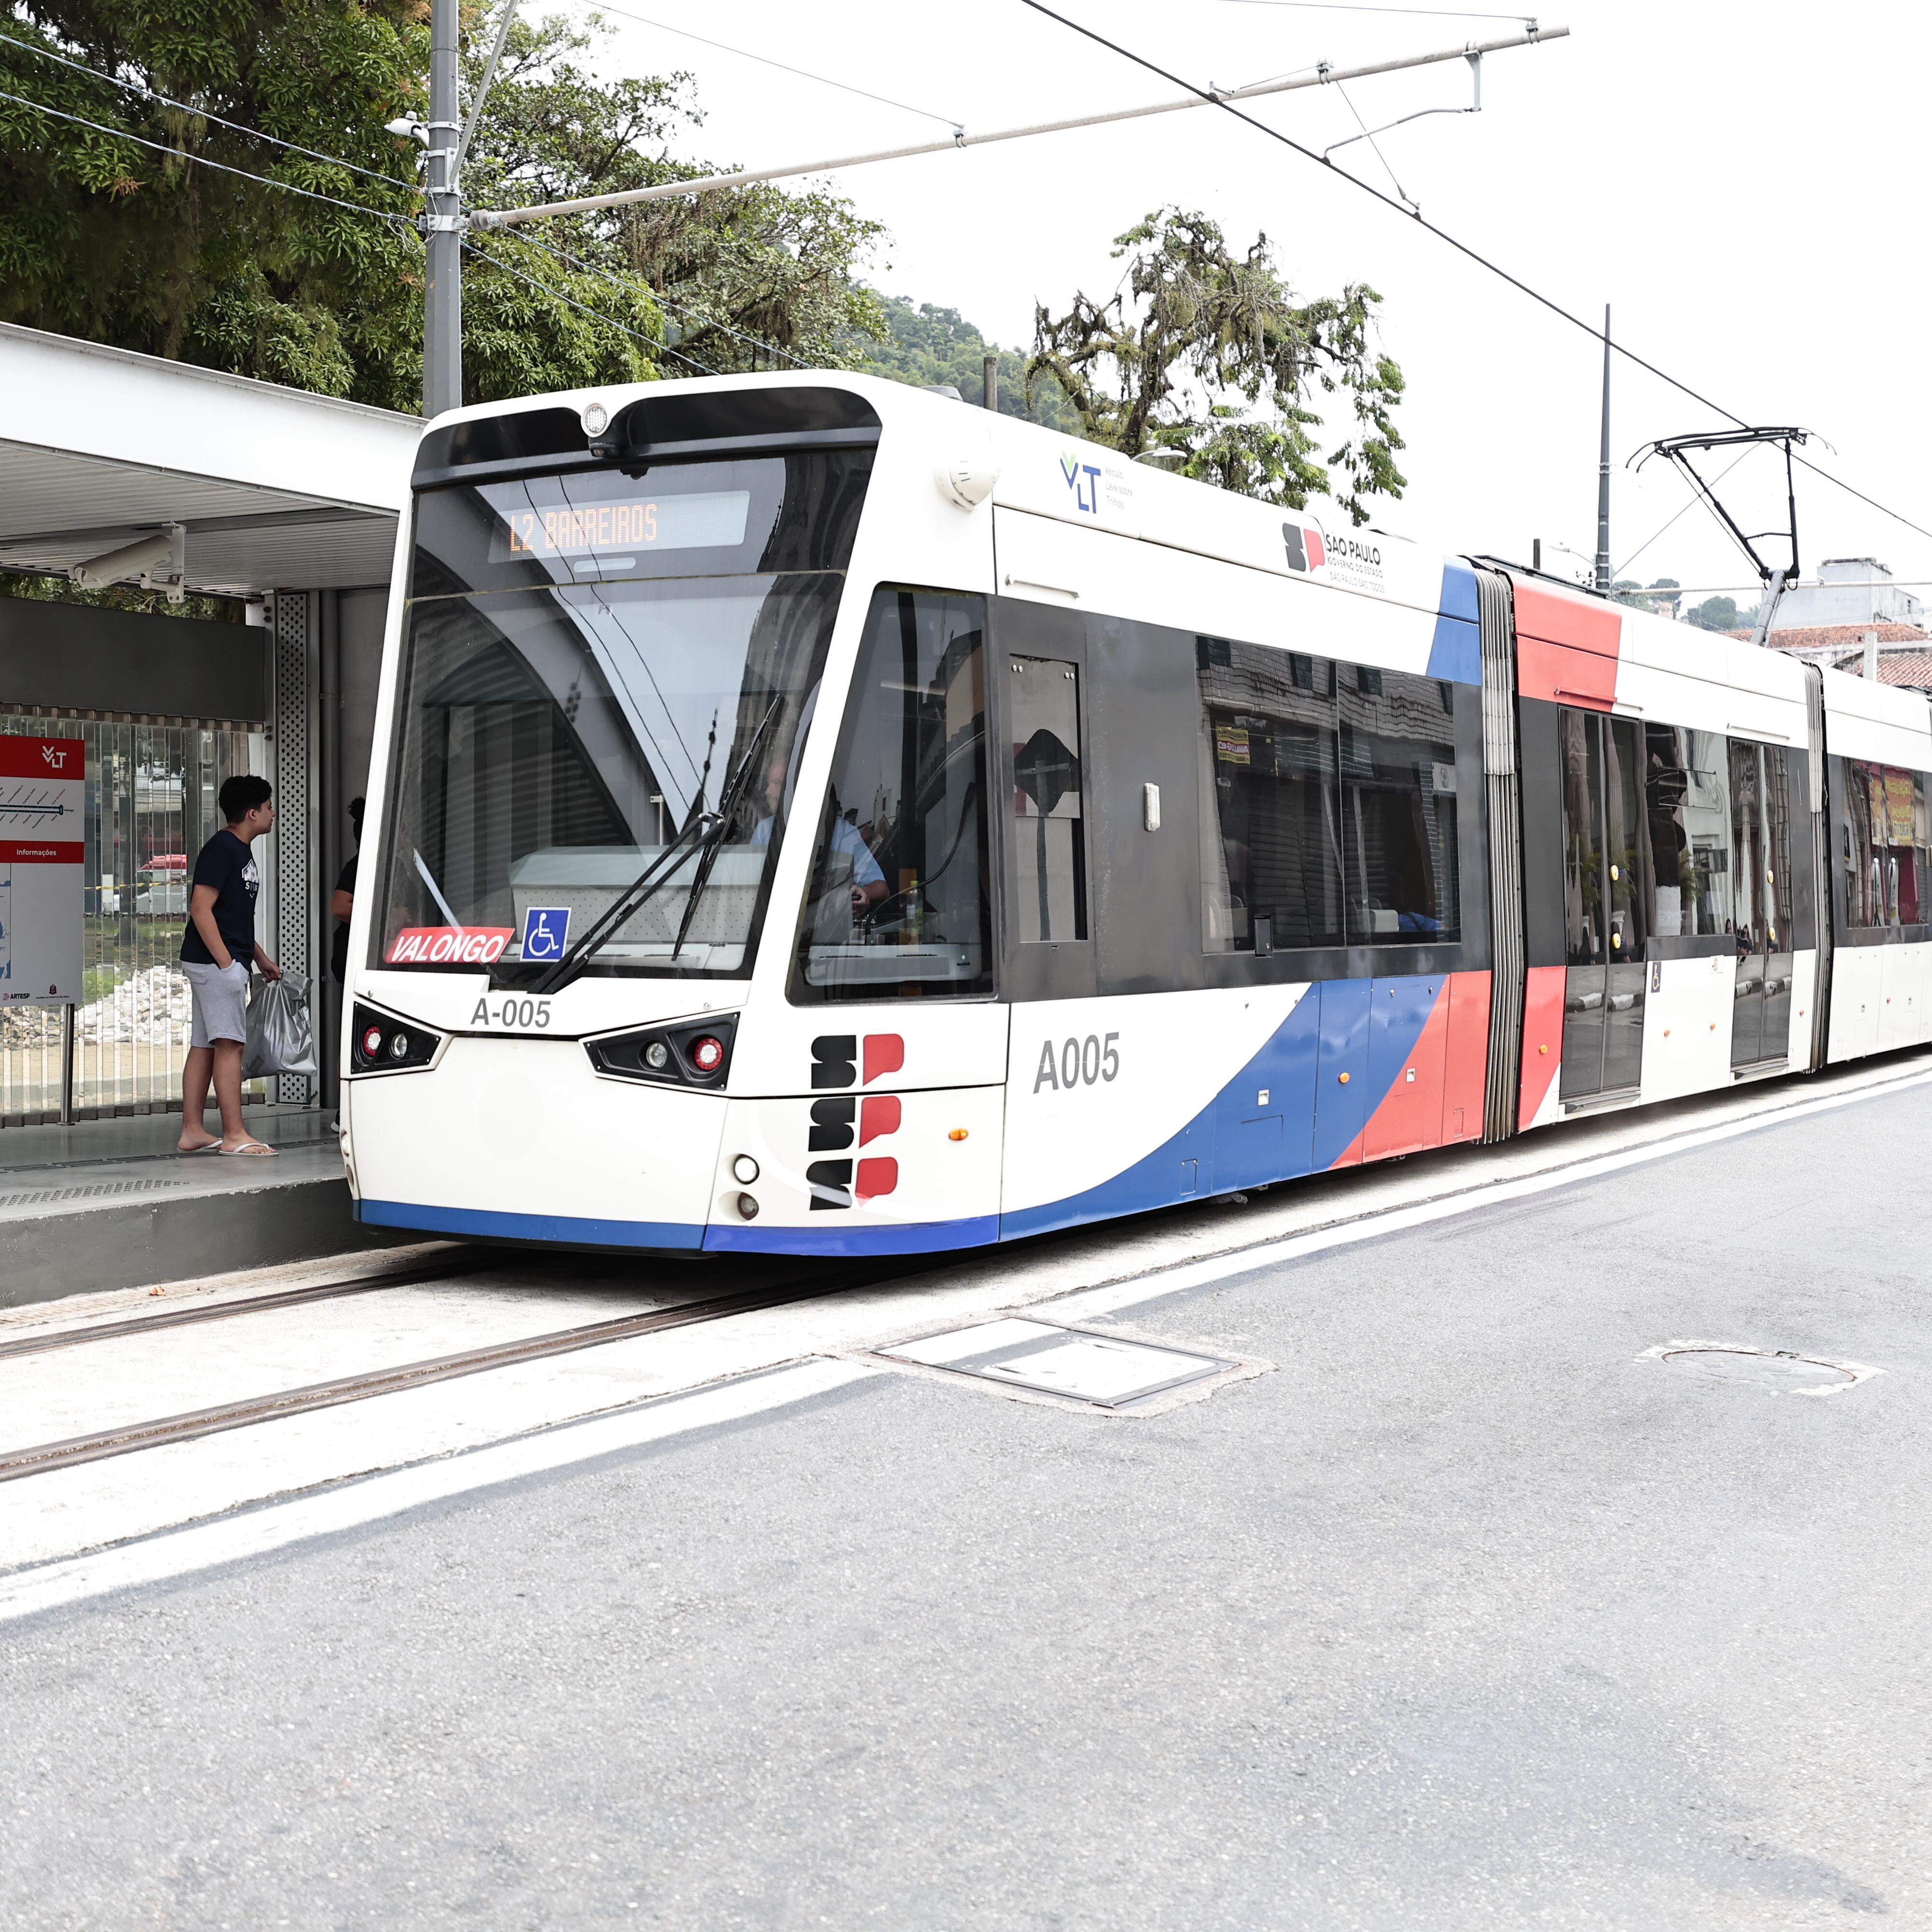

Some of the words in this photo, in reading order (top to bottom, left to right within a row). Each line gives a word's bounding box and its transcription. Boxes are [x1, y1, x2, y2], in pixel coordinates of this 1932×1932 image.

[1060, 451, 1101, 514] VLT
[510, 514, 534, 551] L2
[545, 504, 657, 549] BARREIROS
[1328, 556, 1354, 570] GOVERNO
[1356, 564, 1363, 573] DO
[1364, 566, 1383, 578] ESTADO
[1349, 540, 1380, 566] PAULO
[1342, 574, 1357, 586] PAULO
[1369, 582, 1385, 593] TODOS
[391, 935, 504, 962] VALONGO
[470, 998, 551, 1028] A-005
[1033, 1032, 1119, 1094] A005
